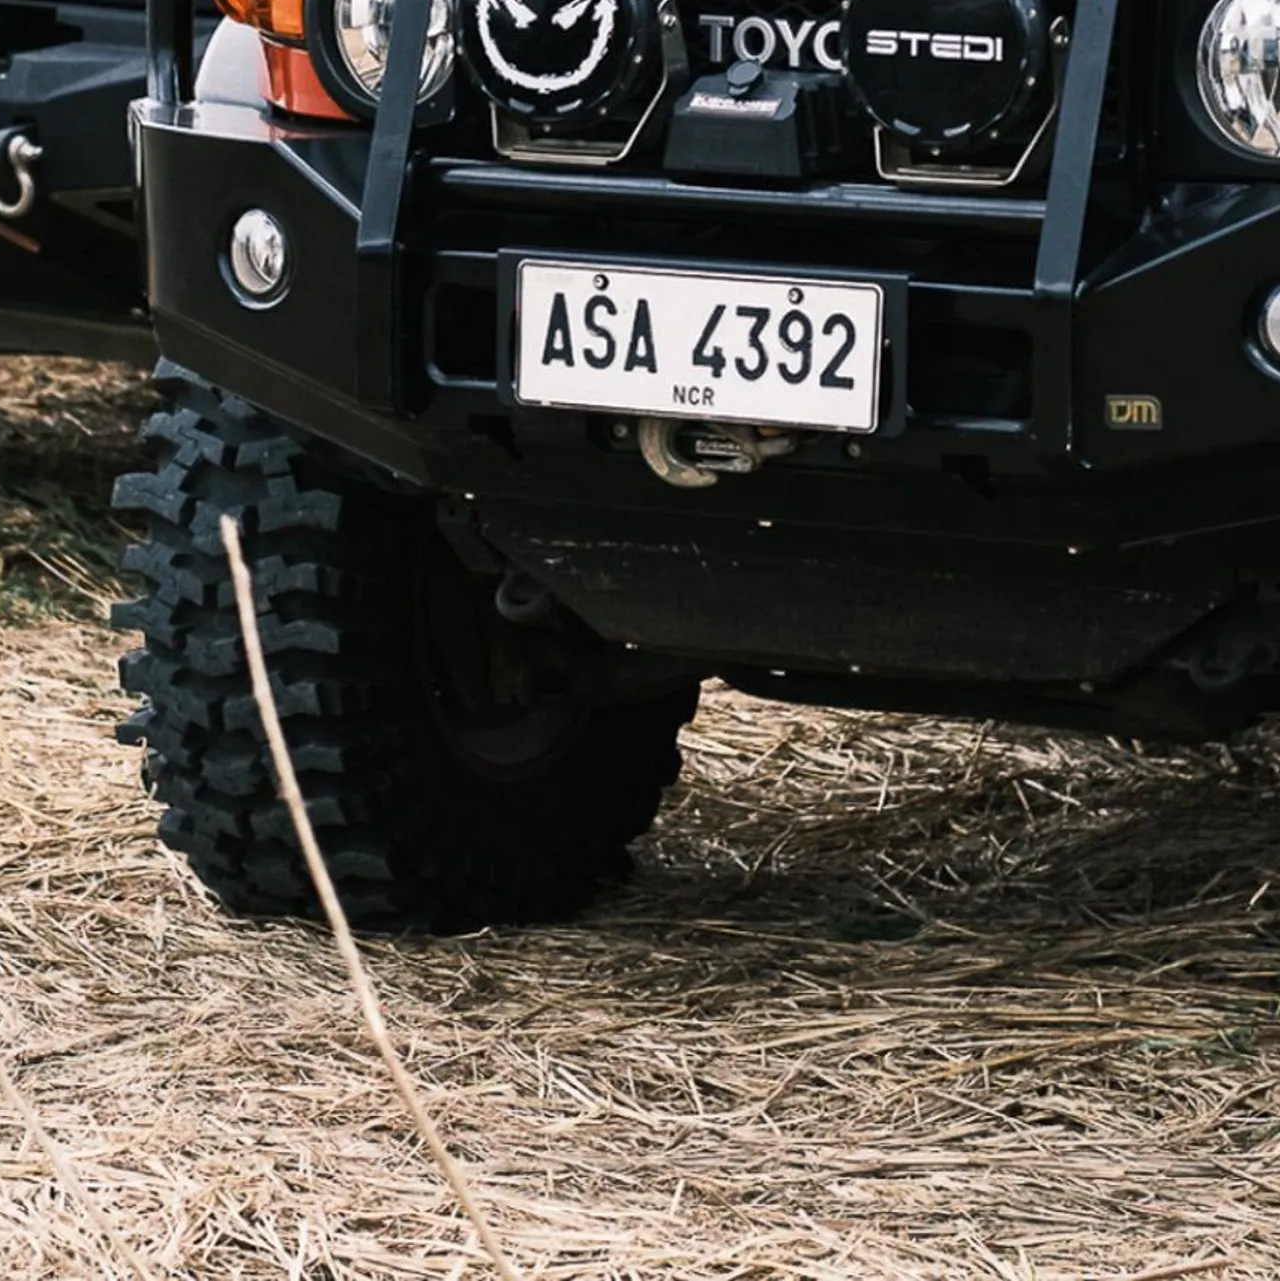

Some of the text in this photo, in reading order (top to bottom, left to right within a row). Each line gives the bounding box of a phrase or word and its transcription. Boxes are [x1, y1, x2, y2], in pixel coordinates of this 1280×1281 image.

[698, 14, 843, 71] TOYO
[866, 29, 1003, 62] STEDI
[542, 292, 856, 391] ASA 4392
[672, 386, 715, 407] NCR
